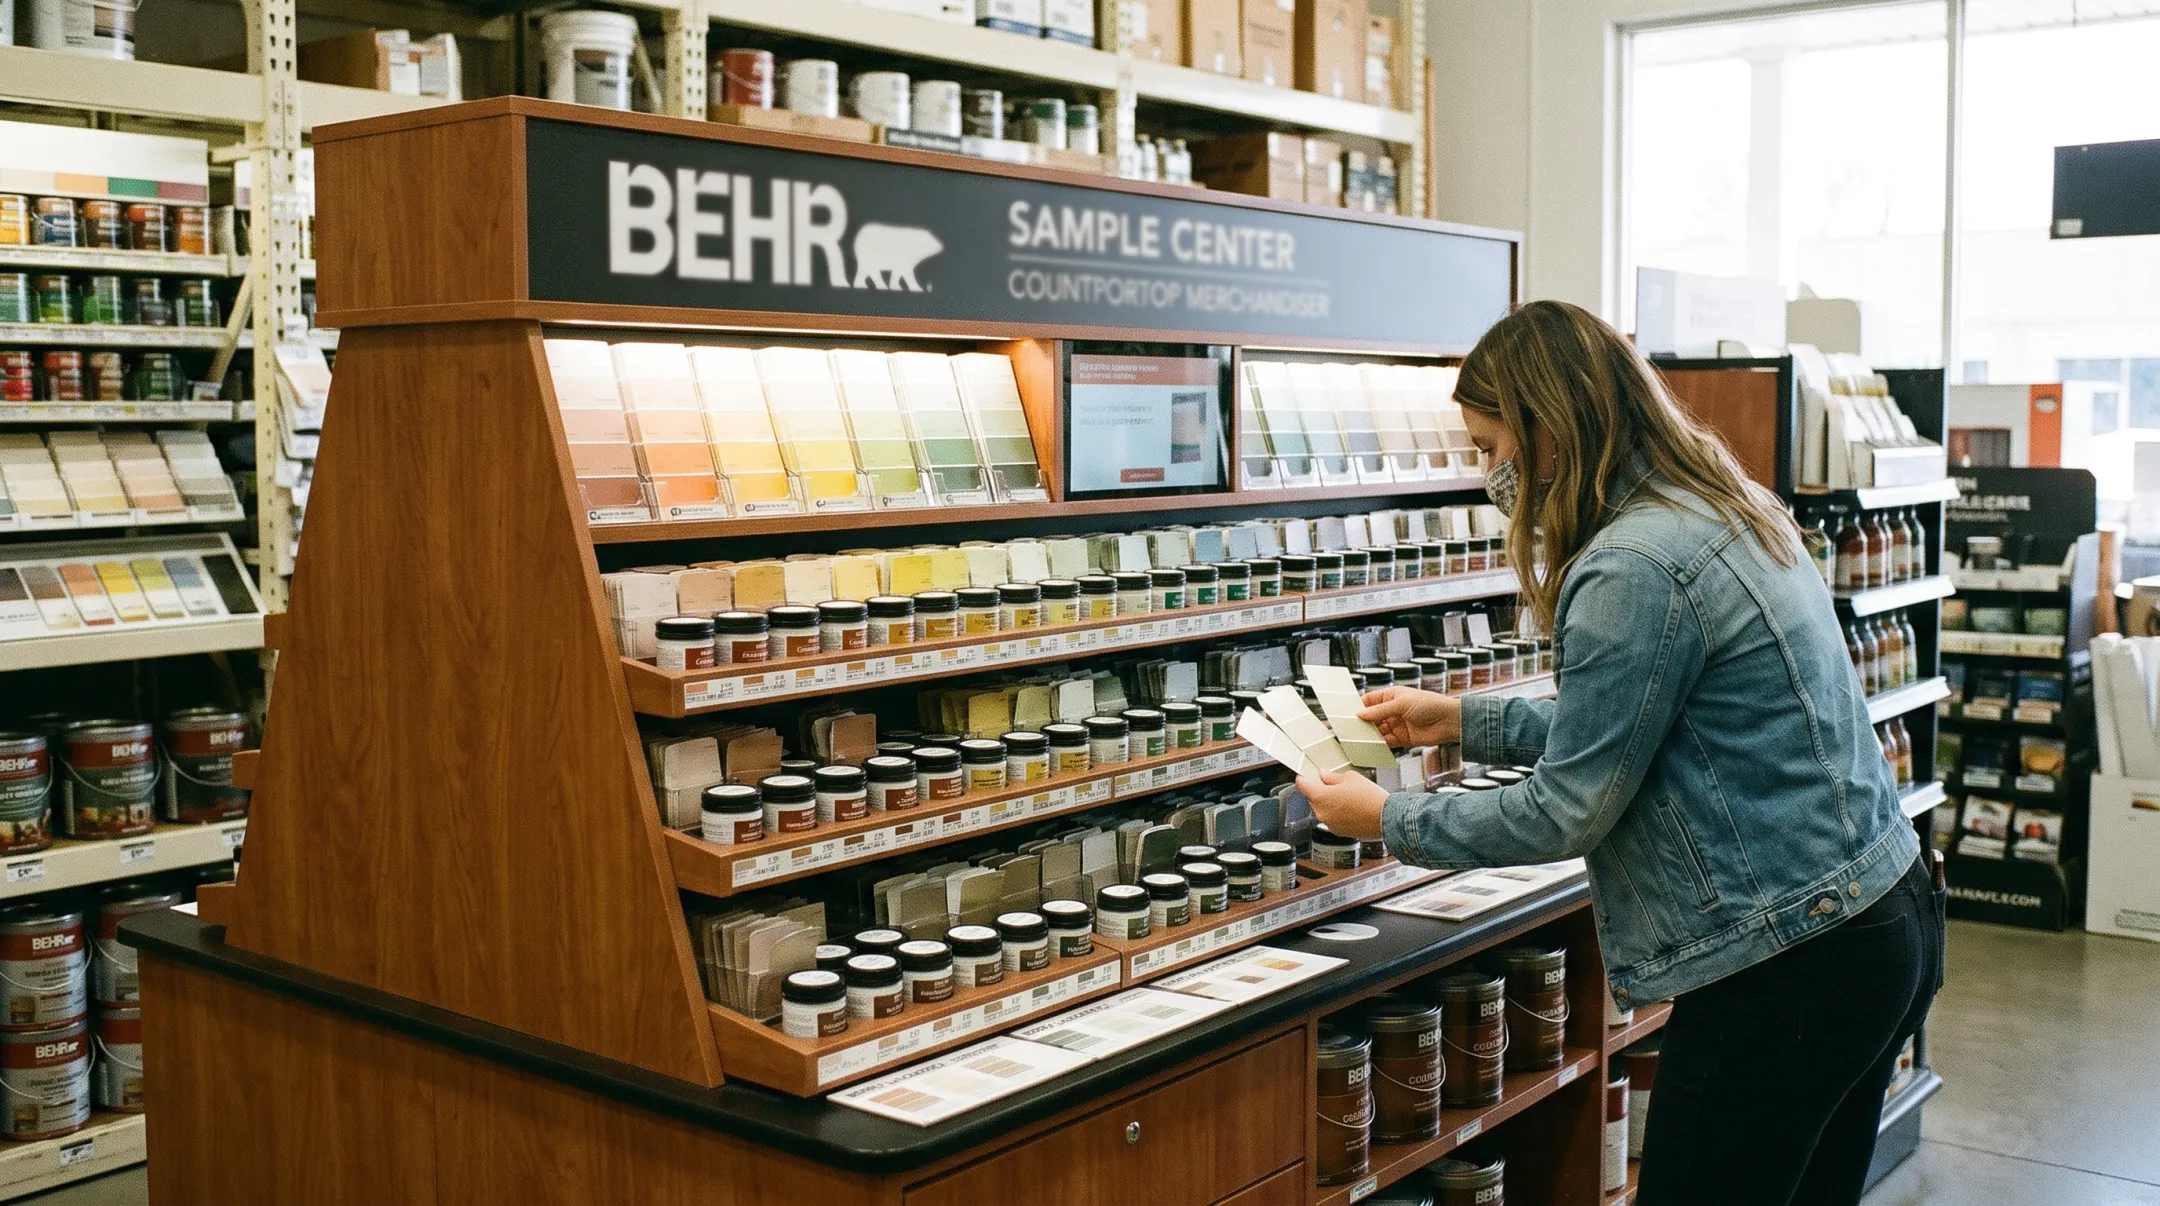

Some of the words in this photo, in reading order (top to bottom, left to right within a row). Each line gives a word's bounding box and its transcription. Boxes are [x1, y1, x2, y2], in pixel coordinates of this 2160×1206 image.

[609, 161, 850, 288] BEHR
[1007, 199, 1161, 259] SAMPLE
[1170, 217, 1296, 271] CENTER
[32, 934, 65, 950] BEHR
[35, 1042, 69, 1059] BEHR
